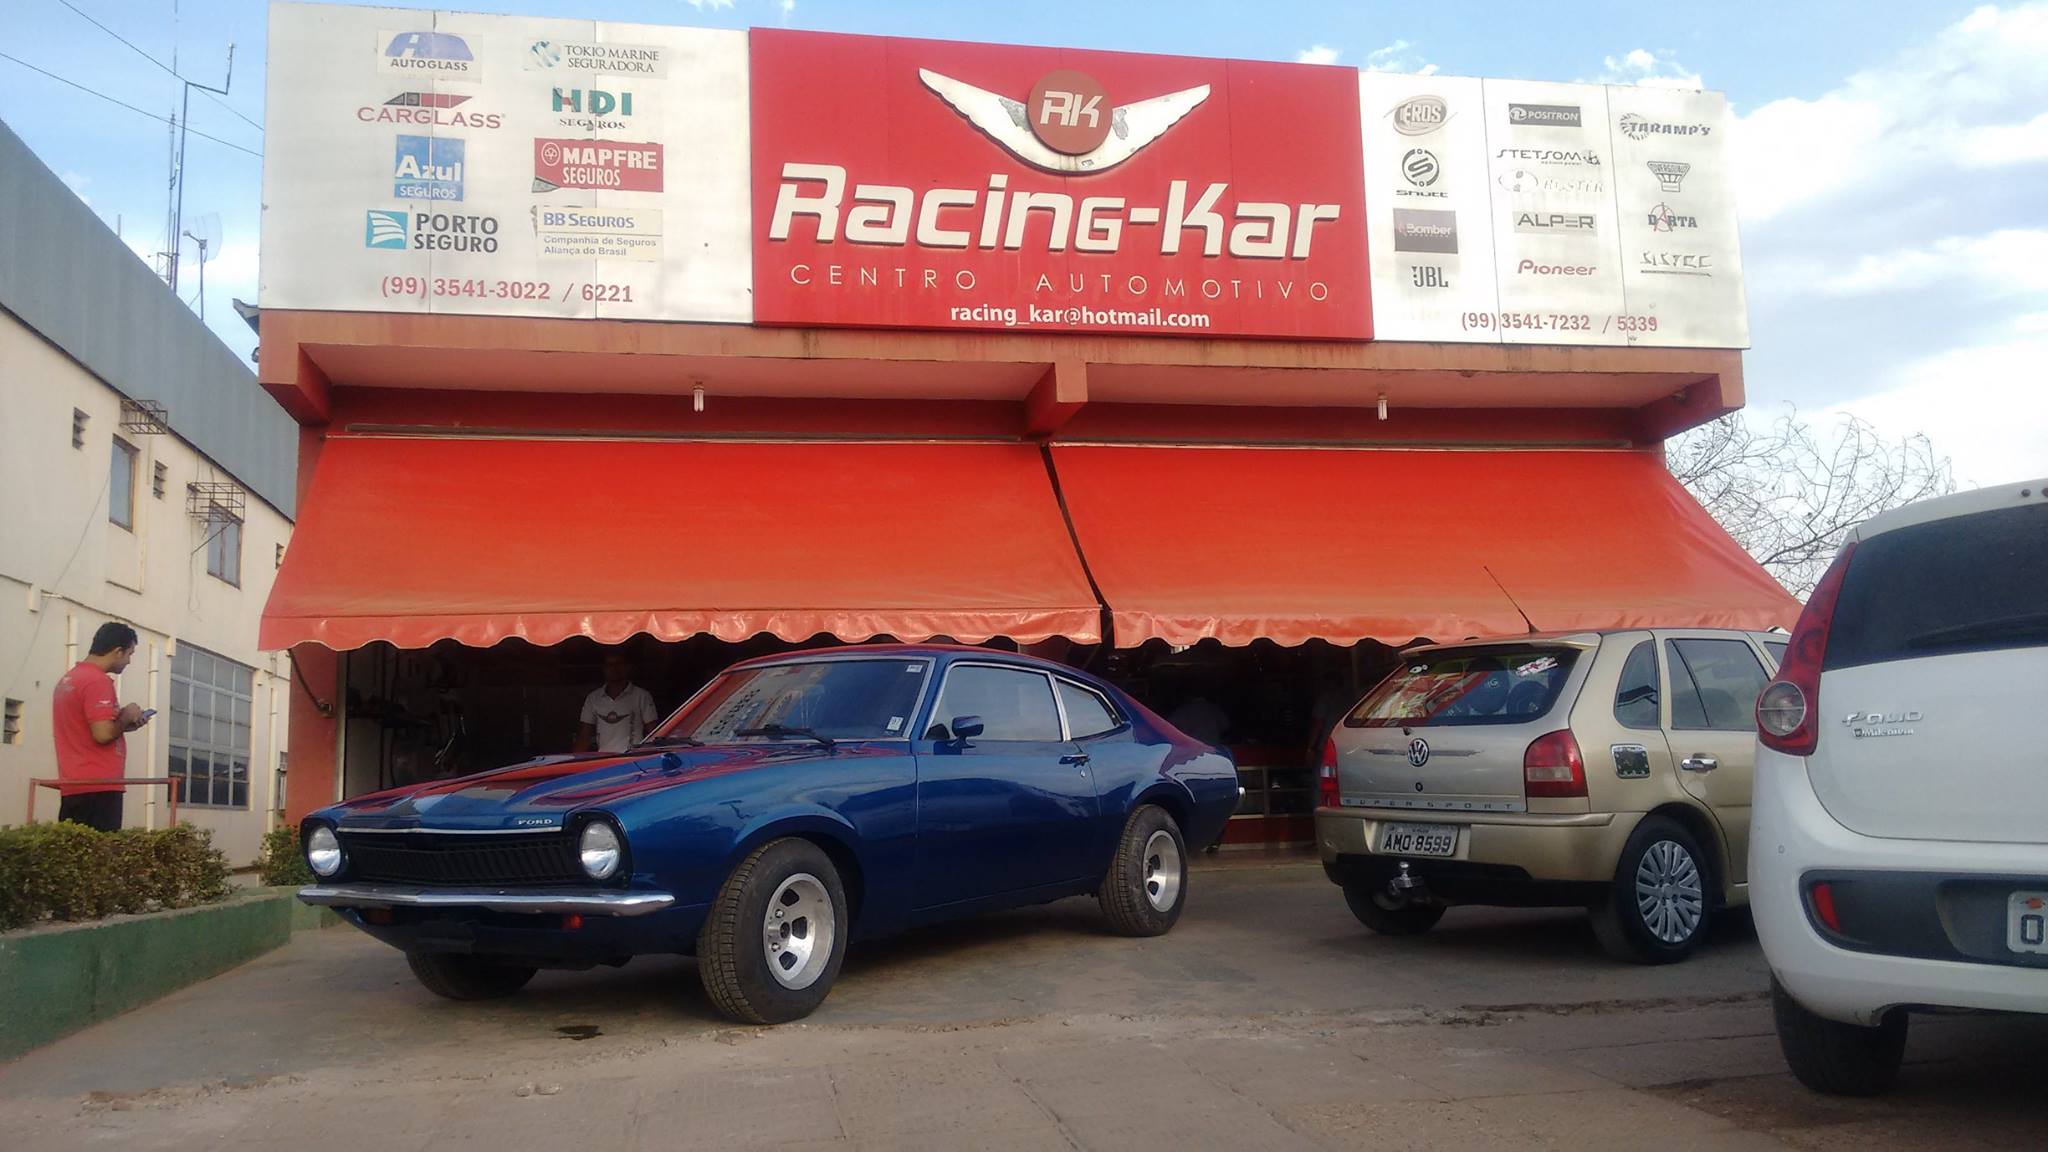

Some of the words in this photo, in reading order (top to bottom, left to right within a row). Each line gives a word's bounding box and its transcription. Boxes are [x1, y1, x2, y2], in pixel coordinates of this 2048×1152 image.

[565, 45, 606, 59] TOKIO
[608, 48, 660, 62] MARINE
[390, 58, 468, 71] AUTOGLASS
[567, 58, 655, 73] SEGURADORA
[552, 88, 632, 116] HDI
[1040, 90, 1103, 128] RK
[357, 106, 502, 129] CARGLASS
[1402, 103, 1442, 123] EROS
[395, 154, 462, 182] Azul
[562, 147, 657, 170] MAPFRE
[562, 167, 621, 186] SEGUROS
[400, 185, 457, 199] SEGUROS
[416, 213, 499, 236] PORTO
[543, 212, 566, 226] BB
[1406, 223, 1451, 235] Bomber
[414, 234, 499, 253] SEGURO
[543, 236, 599, 246] Companhia
[601, 236, 614, 245] de
[616, 237, 657, 248] Seguros
[544, 246, 580, 256] Aliança
[583, 246, 596, 255] do
[598, 247, 627, 256] Brasil
[790, 264, 976, 290] CENTRO
[1035, 273, 1329, 301] AUTOMOTIVO
[1412, 266, 1449, 288] JBL
[381, 276, 427, 299] (99)
[433, 278, 551, 300] 3541-3022
[582, 283, 633, 303] 6221
[951, 303, 1211, 328] racing_kar@hotmail.com
[1461, 312, 1497, 332] (99)
[1501, 313, 1591, 332] 3541-7232
[1617, 315, 1658, 332] 5339
